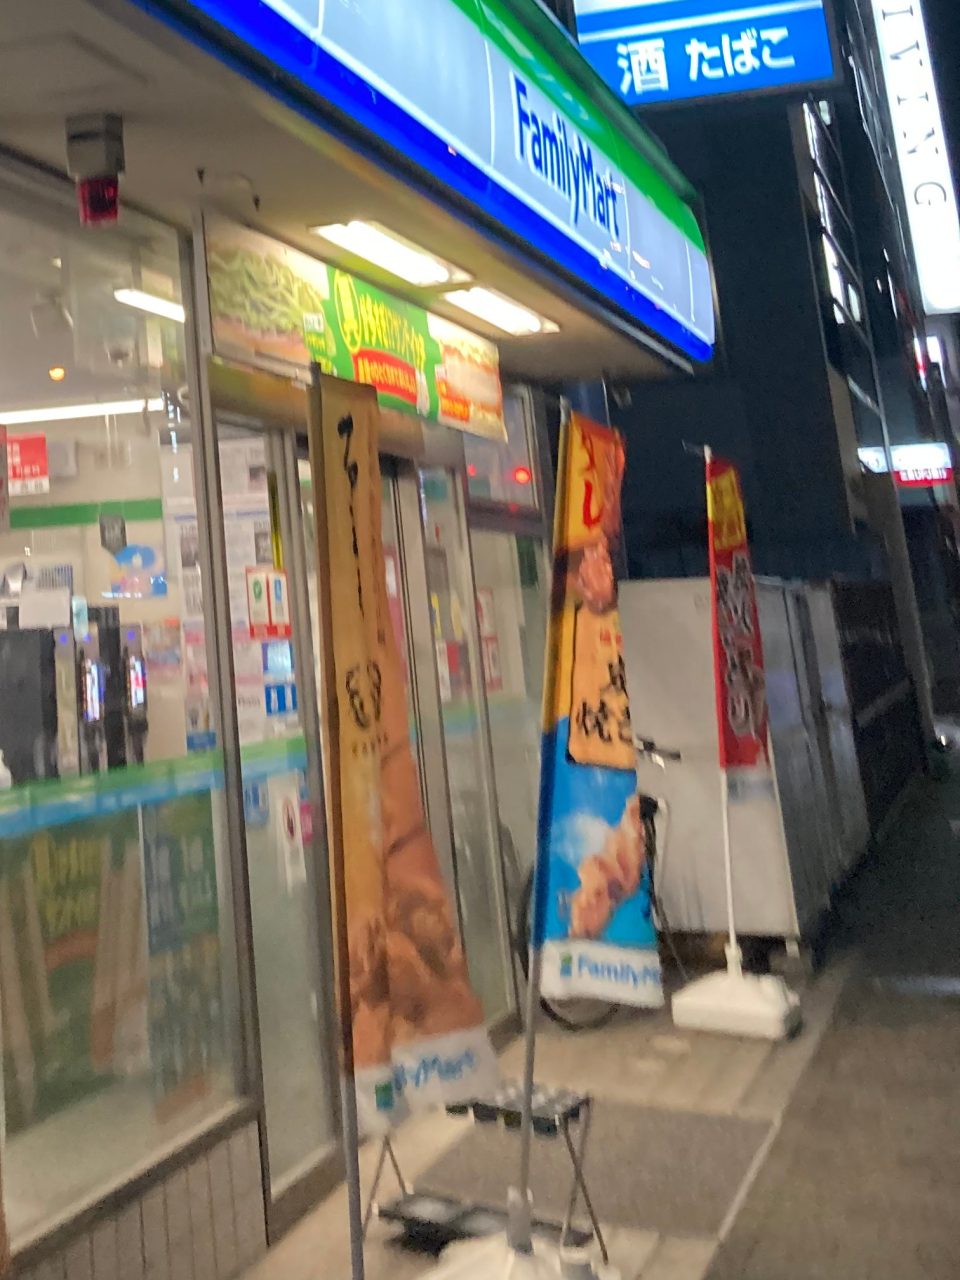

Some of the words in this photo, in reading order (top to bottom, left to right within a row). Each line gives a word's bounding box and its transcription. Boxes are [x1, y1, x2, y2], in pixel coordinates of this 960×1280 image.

[616, 38, 669, 95] 酒
[685, 26, 796, 81] たばこ
[511, 71, 619, 240] FamilyMart
